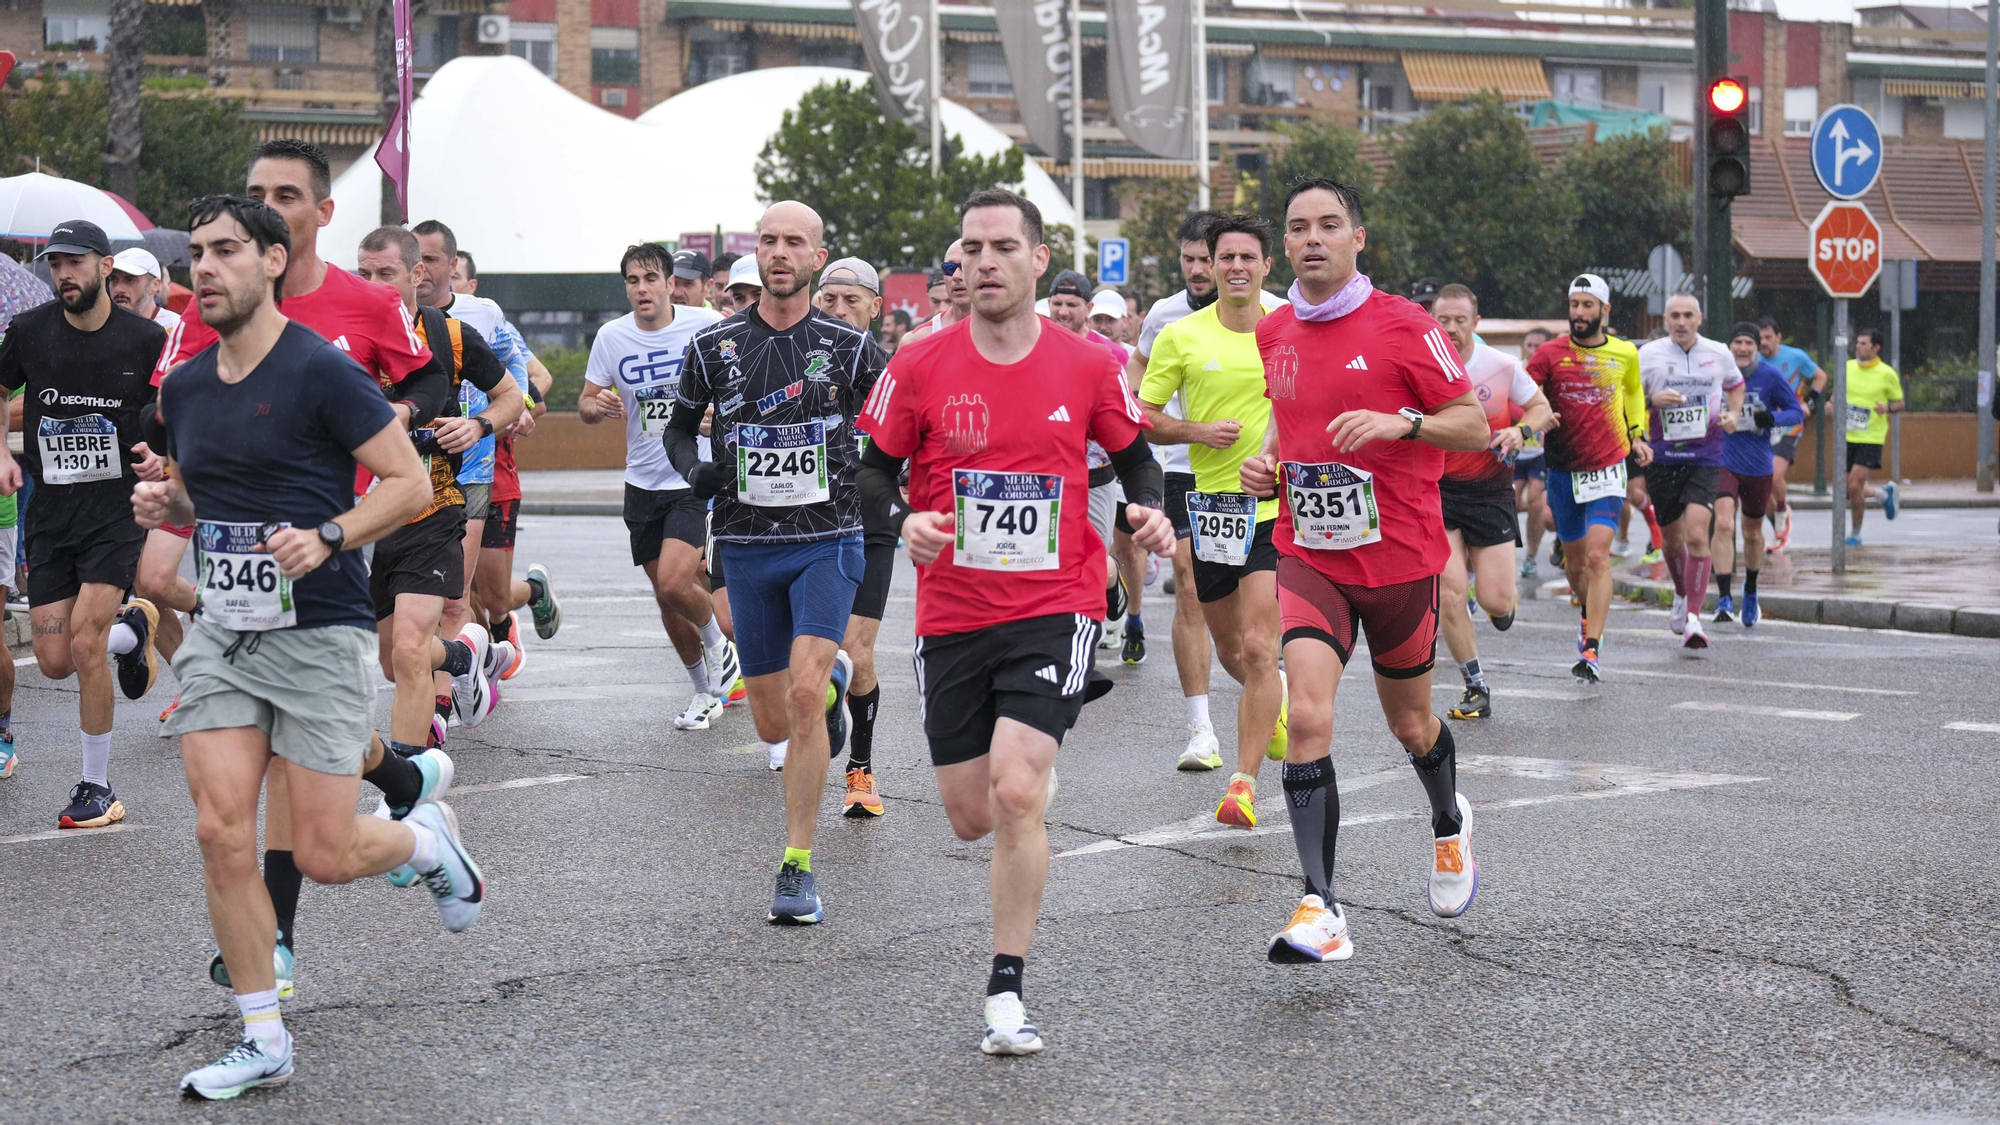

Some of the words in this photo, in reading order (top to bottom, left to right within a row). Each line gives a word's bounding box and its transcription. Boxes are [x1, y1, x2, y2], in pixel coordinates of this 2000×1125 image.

[1104, 244, 1123, 268] P
[1819, 237, 1876, 261] STOP
[60, 395, 122, 408] DECATHLON
[758, 380, 803, 413] MRW
[1667, 409, 1702, 424] 2287
[776, 425, 807, 435] MEDIA
[45, 436, 111, 451] LIEBRE
[747, 433, 763, 446] 39
[53, 455, 89, 469] 1:30
[95, 454, 109, 469] H
[747, 450, 816, 477] 2246
[1317, 464, 1343, 474] MEDI
[1004, 475, 1040, 485] MEDIA
[1580, 466, 1618, 485] 2811
[967, 481, 986, 497] 39
[1293, 488, 1361, 518] 2351
[977, 504, 1037, 535] 740
[228, 526, 257, 537] MEDI
[1197, 515, 1246, 540] 2956
[1340, 534, 1366, 543] IMDECO
[226, 544, 254, 553] CÓRD
[206, 557, 277, 593] 2346
[225, 599, 250, 608] RAFAEL
